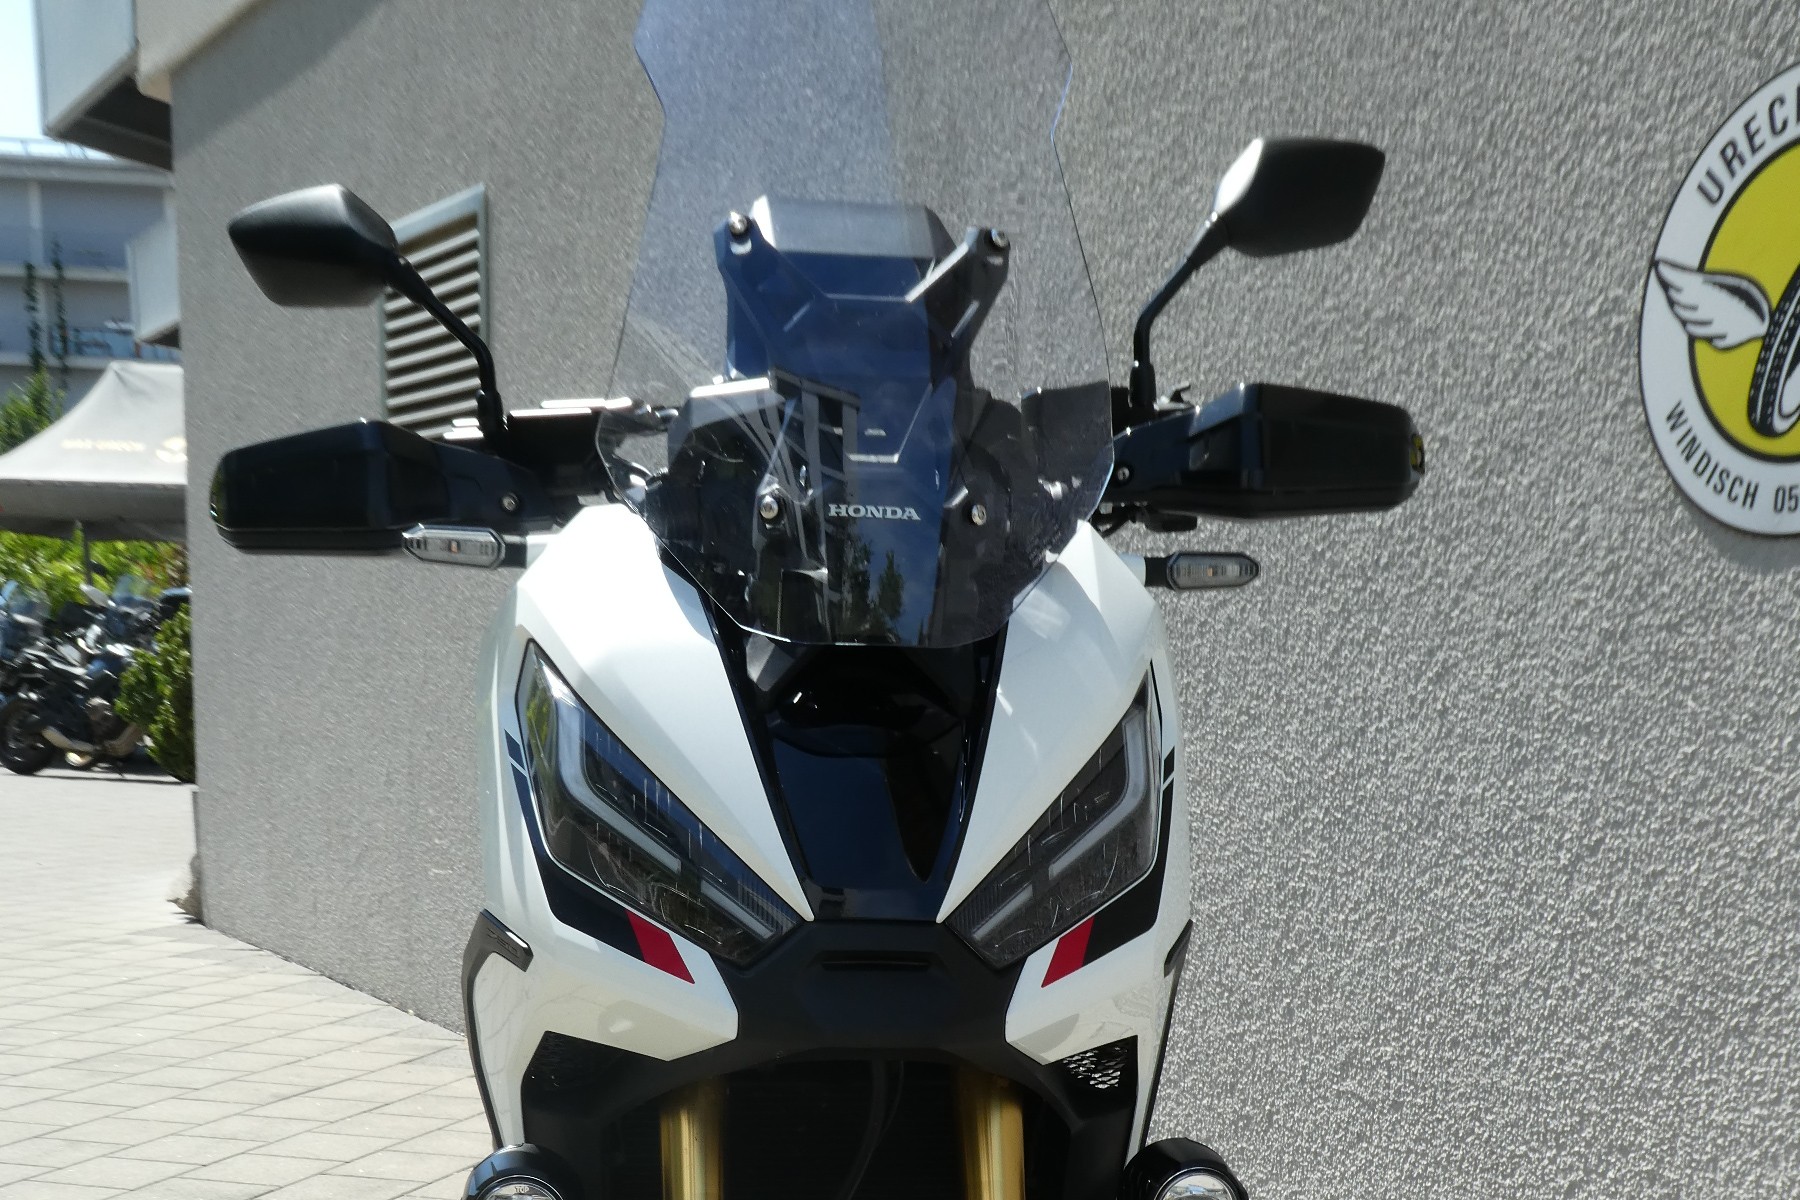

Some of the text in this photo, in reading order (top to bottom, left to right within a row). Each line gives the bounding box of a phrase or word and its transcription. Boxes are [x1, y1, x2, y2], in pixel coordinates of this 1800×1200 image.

[1697, 84, 1800, 205] UREC
[1665, 400, 1759, 510] WINDISCH
[828, 503, 922, 521] HONDA
